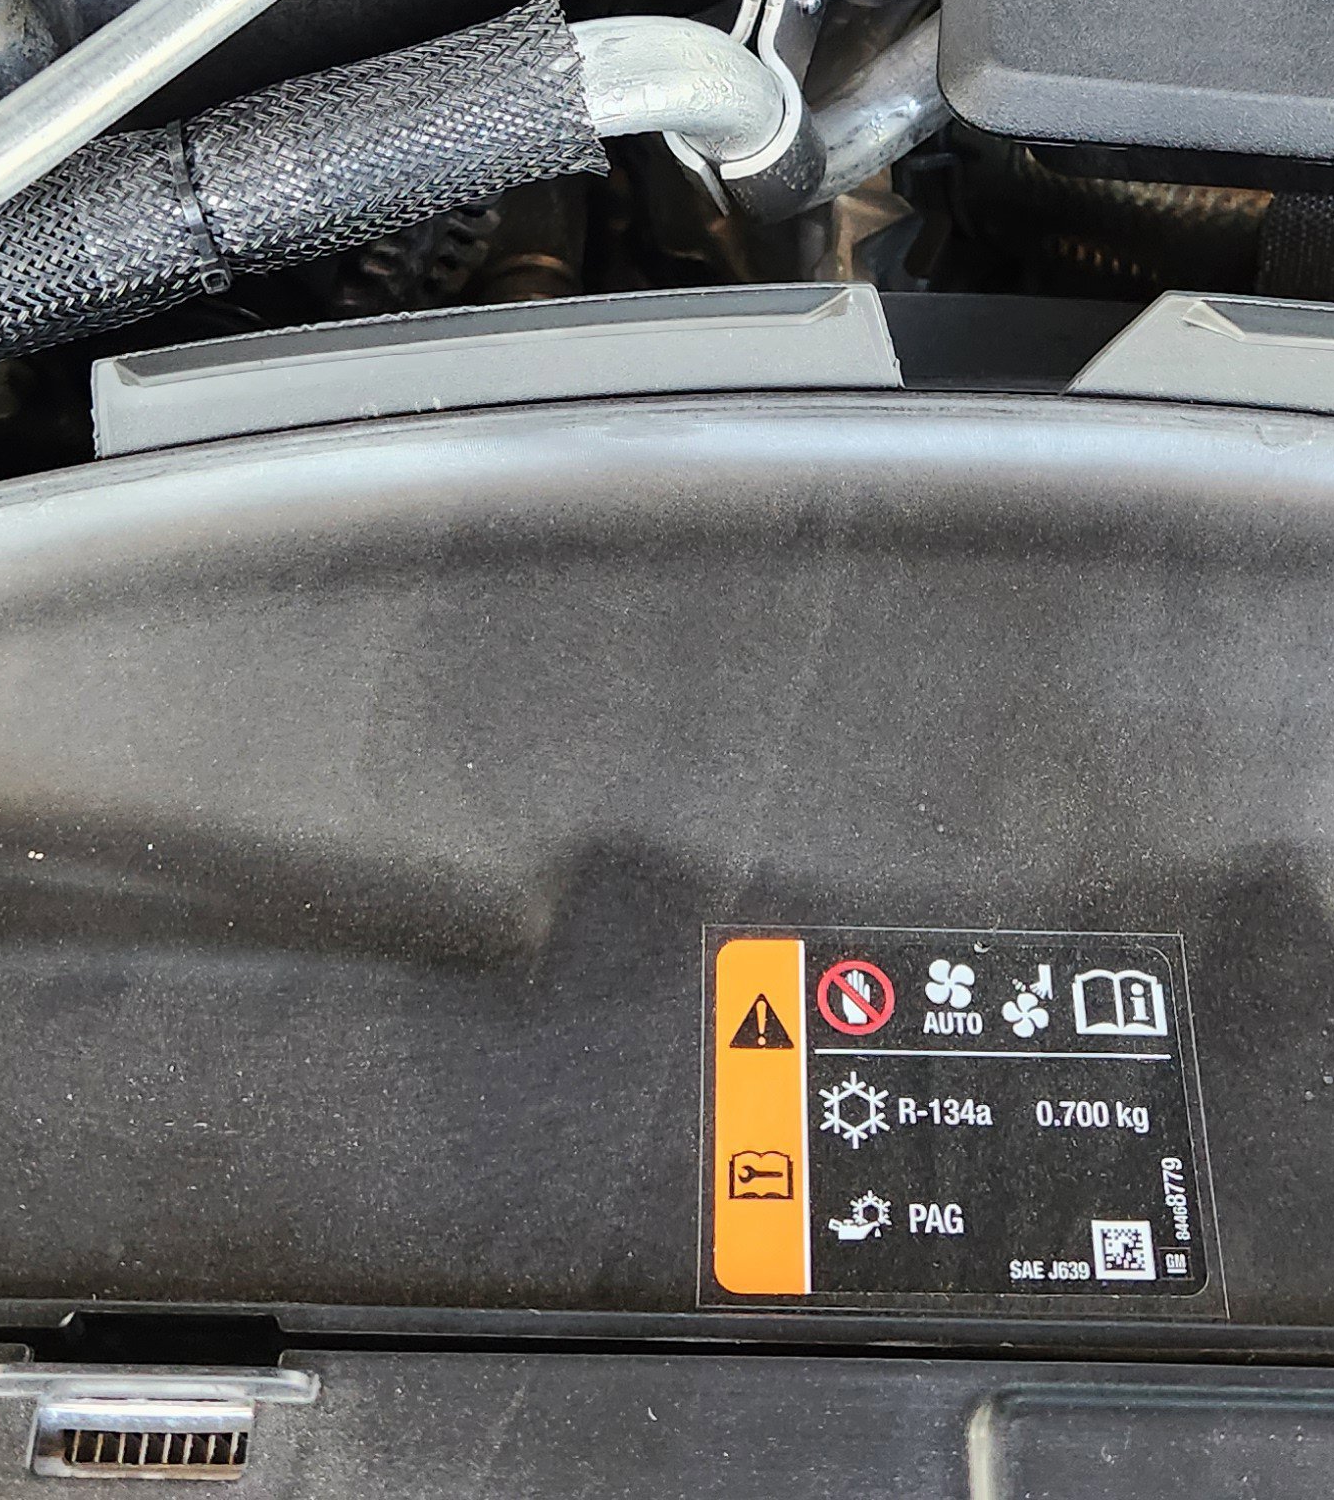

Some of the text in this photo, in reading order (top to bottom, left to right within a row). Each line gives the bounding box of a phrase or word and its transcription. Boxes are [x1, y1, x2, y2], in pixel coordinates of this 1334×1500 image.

[923, 1011, 983, 1036] AUTO
[897, 1098, 1151, 1133] R-134a 0.700 kg
[1161, 1156, 1192, 1241] 84468779
[908, 1203, 966, 1234] PAG
[1009, 1260, 1090, 1280] SAE J639
[1166, 1252, 1188, 1275] GM
